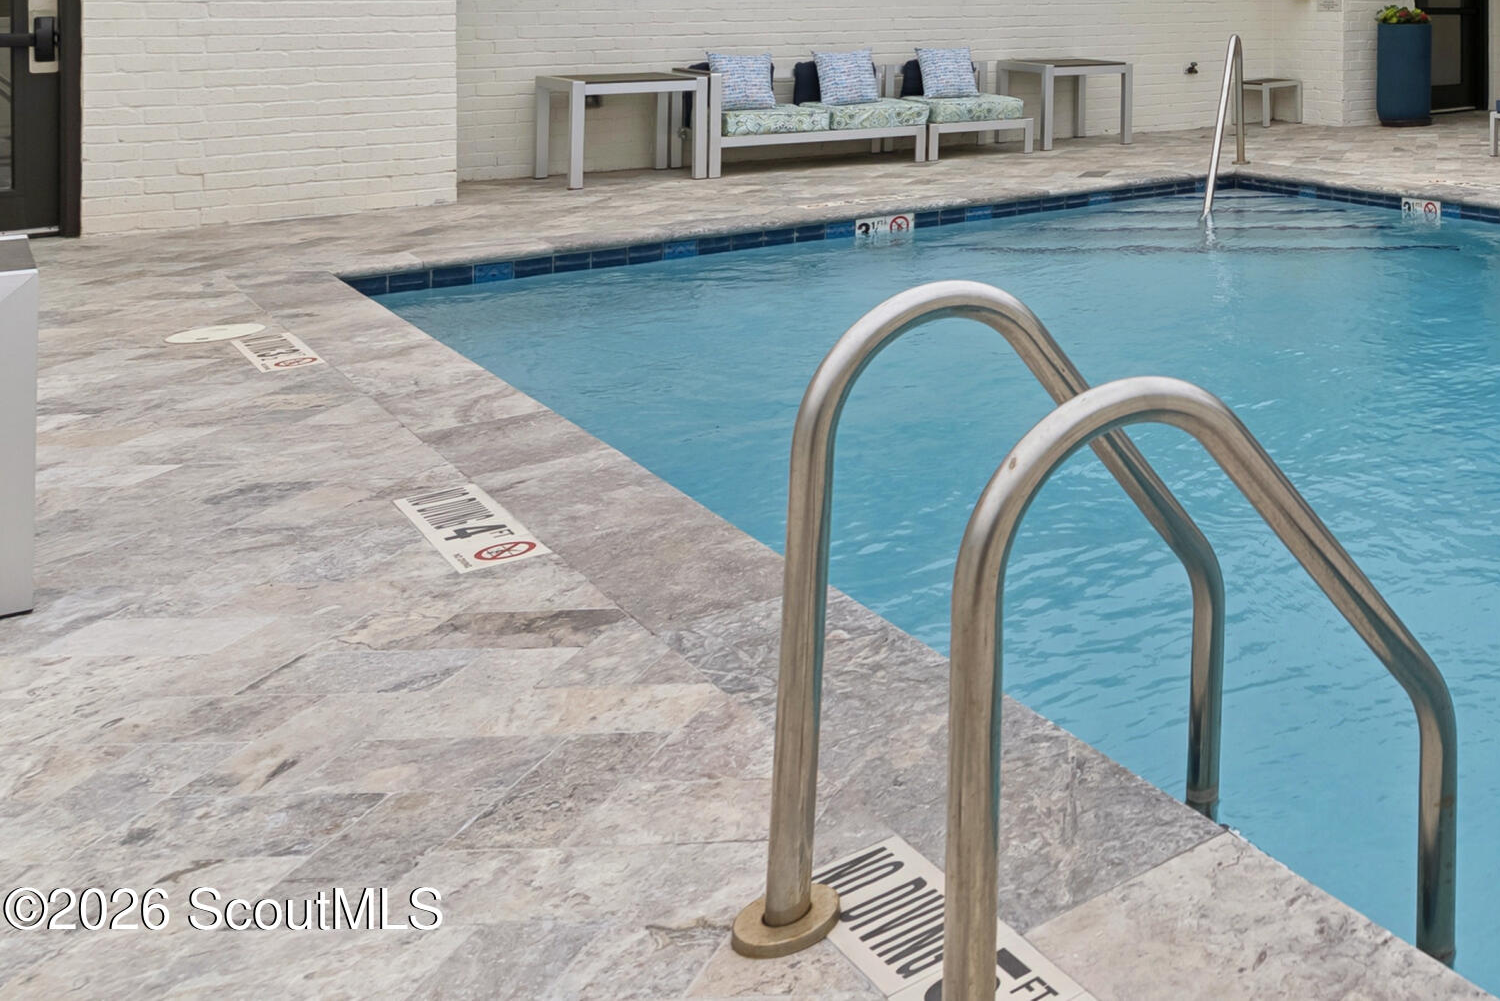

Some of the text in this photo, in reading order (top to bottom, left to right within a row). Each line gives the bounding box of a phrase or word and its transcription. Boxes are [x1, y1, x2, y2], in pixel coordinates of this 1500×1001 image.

[406, 487, 470, 506] NO
[416, 497, 495, 530] DIVING
[444, 524, 508, 542] 4
